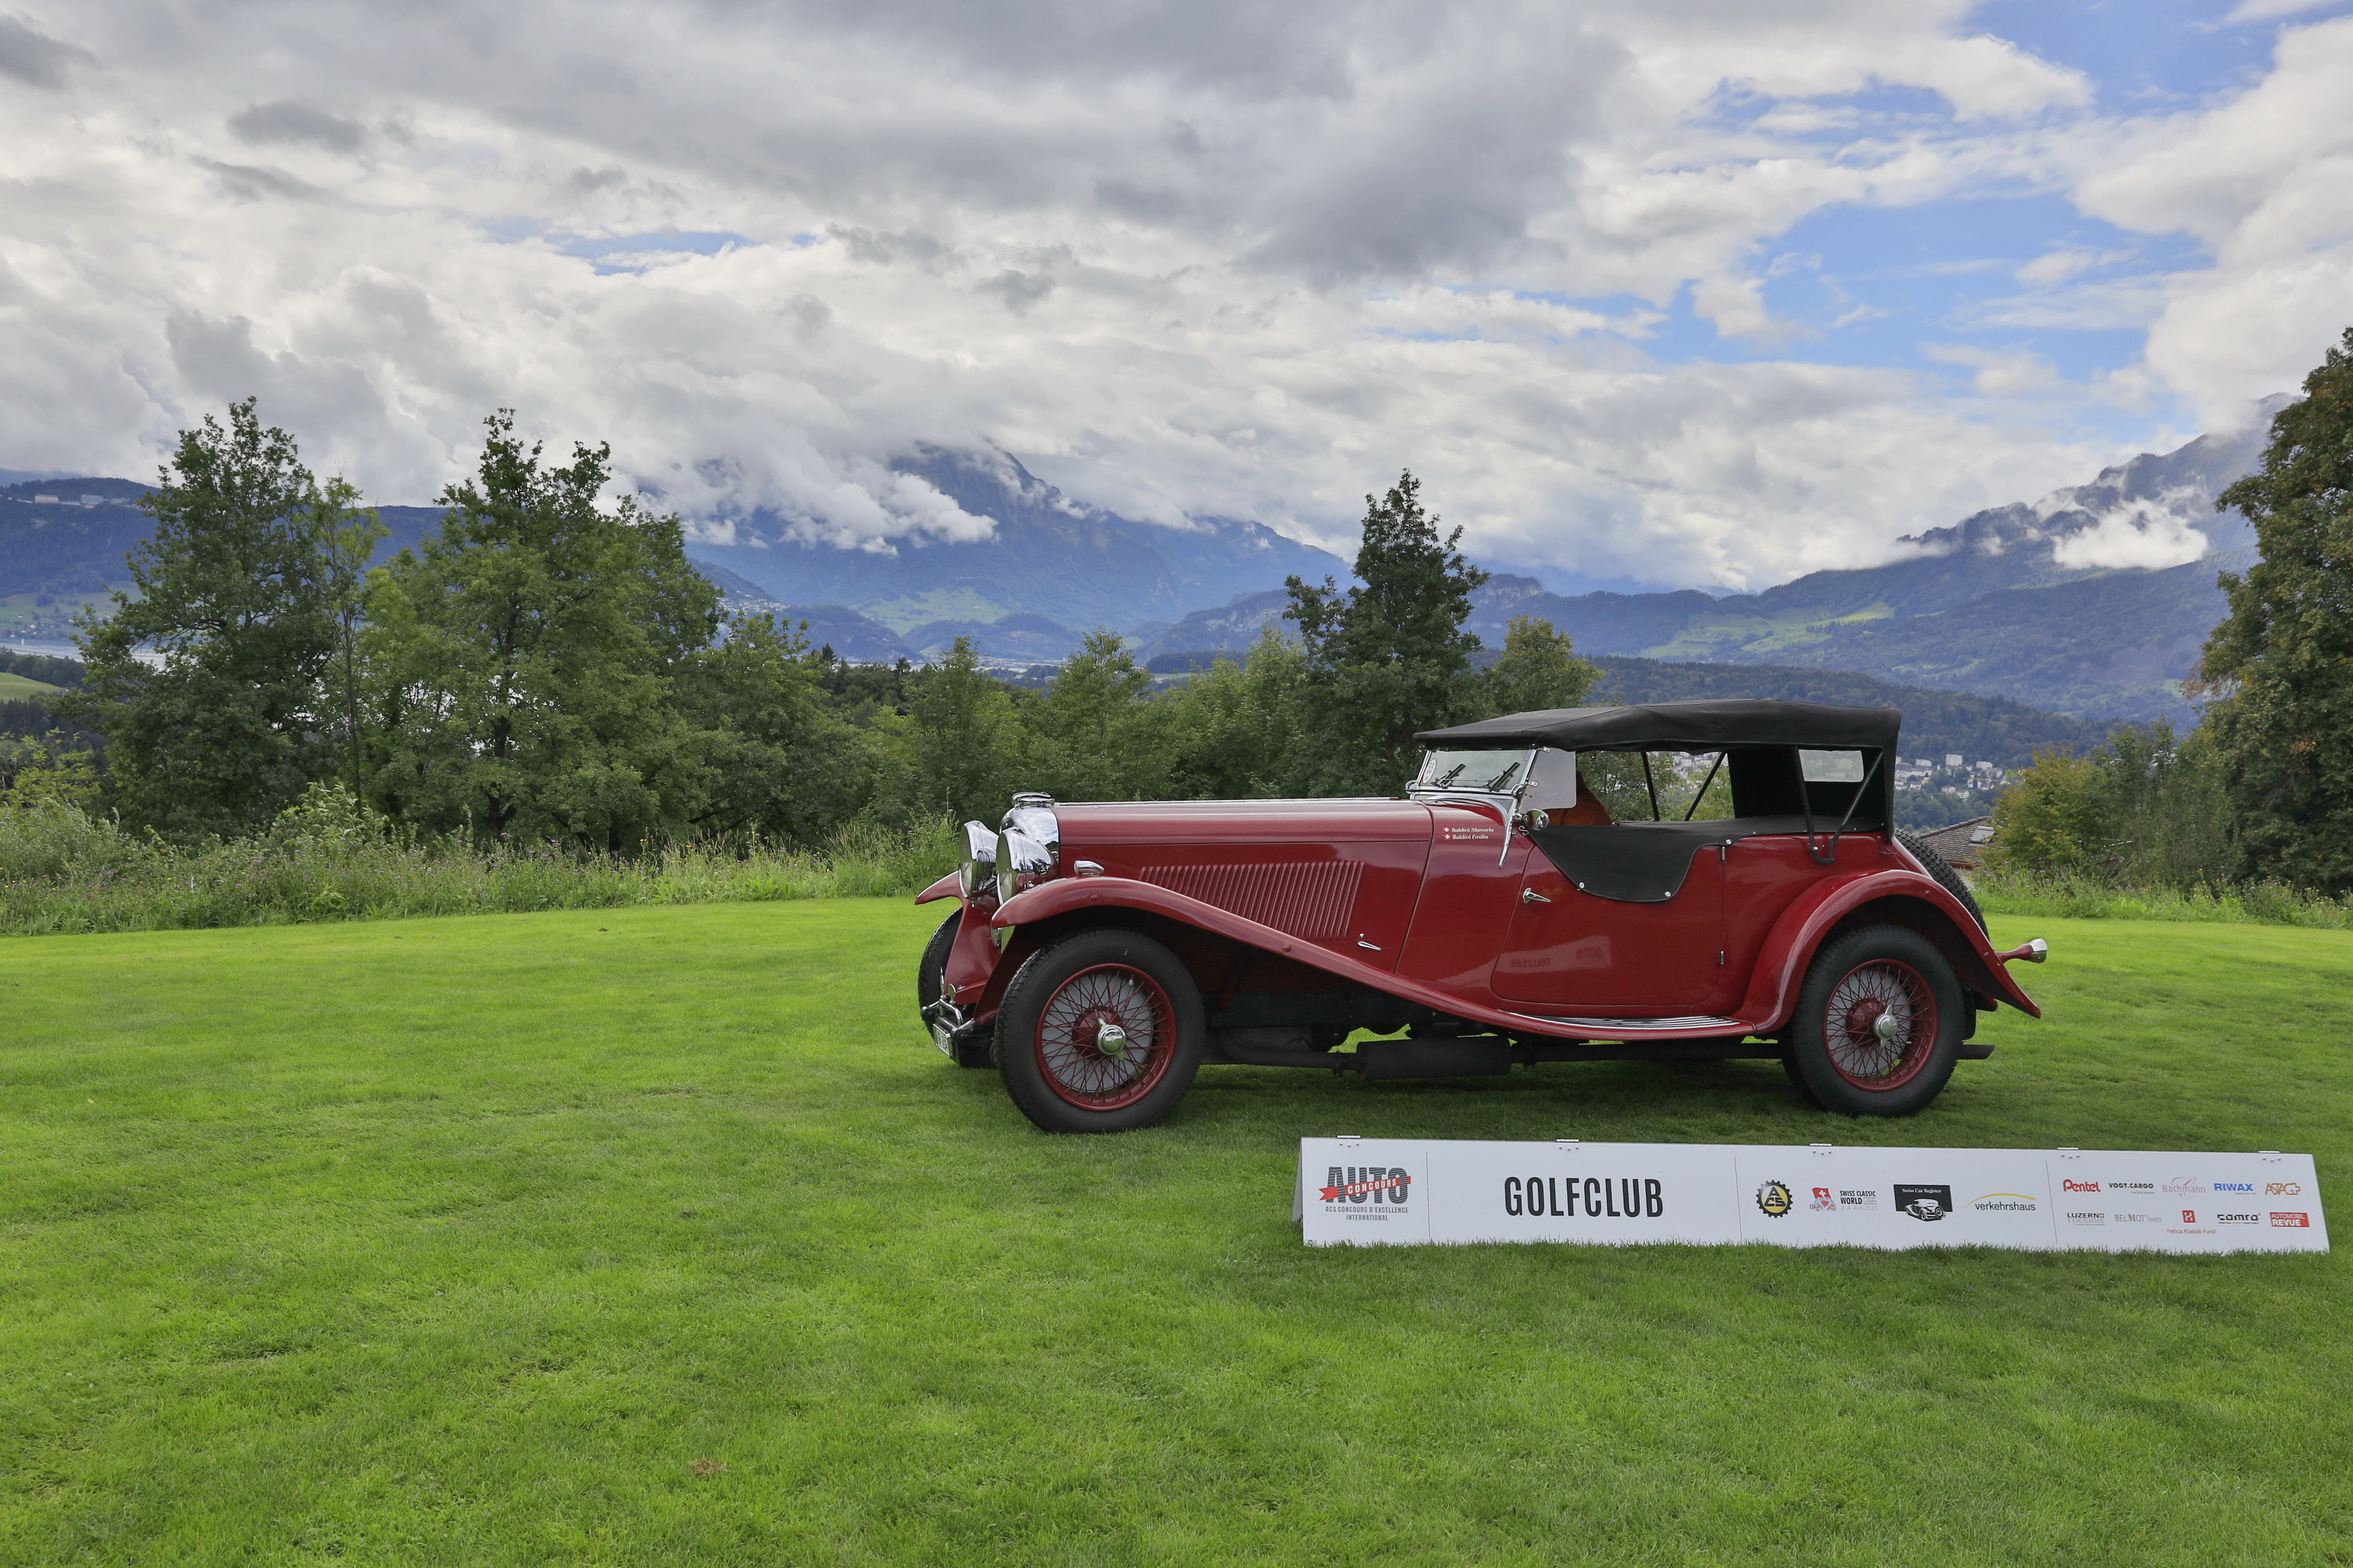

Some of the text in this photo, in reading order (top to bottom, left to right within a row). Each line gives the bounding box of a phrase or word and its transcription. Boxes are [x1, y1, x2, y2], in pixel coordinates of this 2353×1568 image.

[1326, 1167, 1408, 1204] AUTO
[1347, 1179, 1397, 1194] CONCOURS
[2063, 1179, 2101, 1192] Pentel
[2162, 1184, 2206, 1193] Bachmann
[2214, 1183, 2254, 1191] RIWAX
[1504, 1177, 1663, 1218] GOLFCLUB
[1975, 1201, 2036, 1211] verkehrshaus
